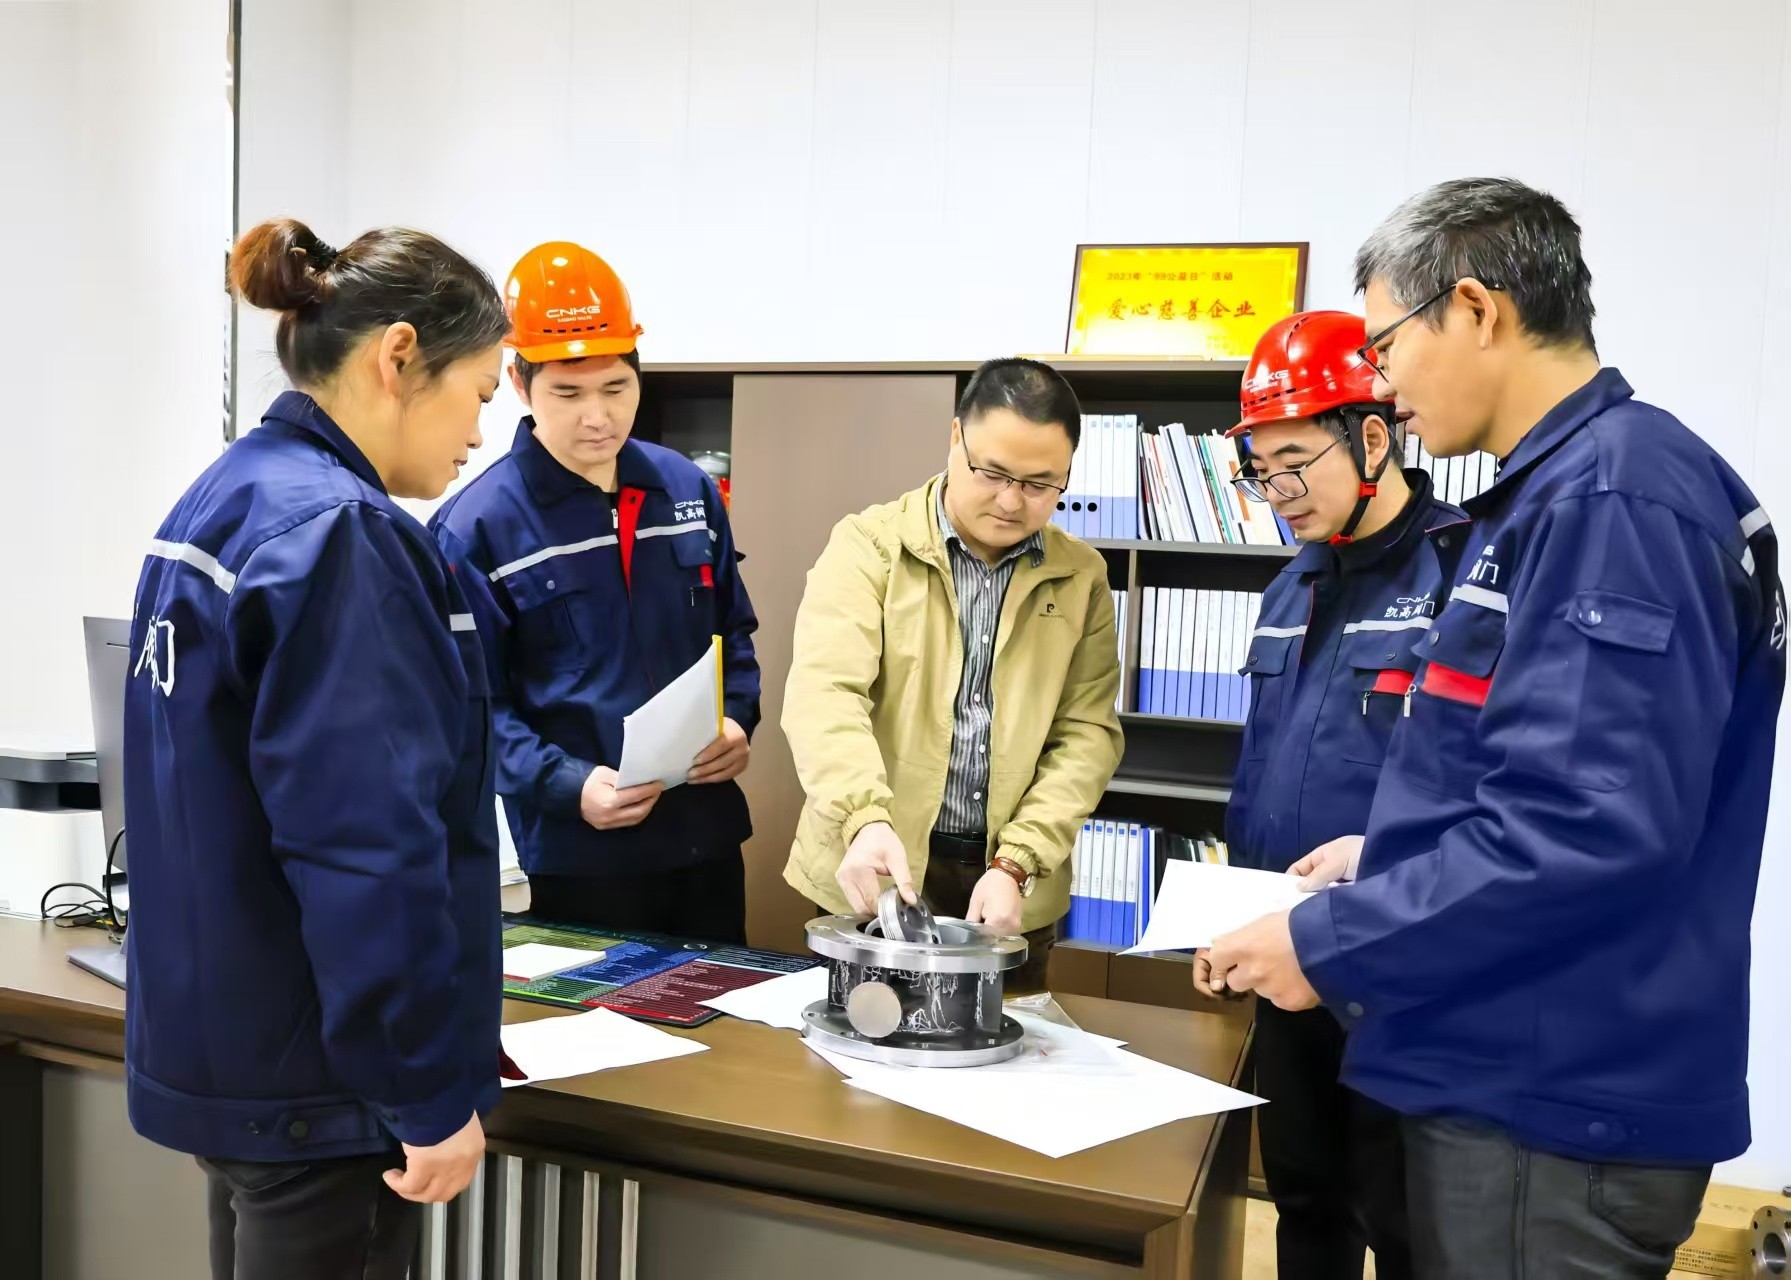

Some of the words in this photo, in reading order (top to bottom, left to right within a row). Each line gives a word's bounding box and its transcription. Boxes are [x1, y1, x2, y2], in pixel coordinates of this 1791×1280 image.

[546, 305, 601, 318] CNKG
[1107, 297, 1256, 321] 爱心慈善企业
[1245, 369, 1290, 390] CKG
